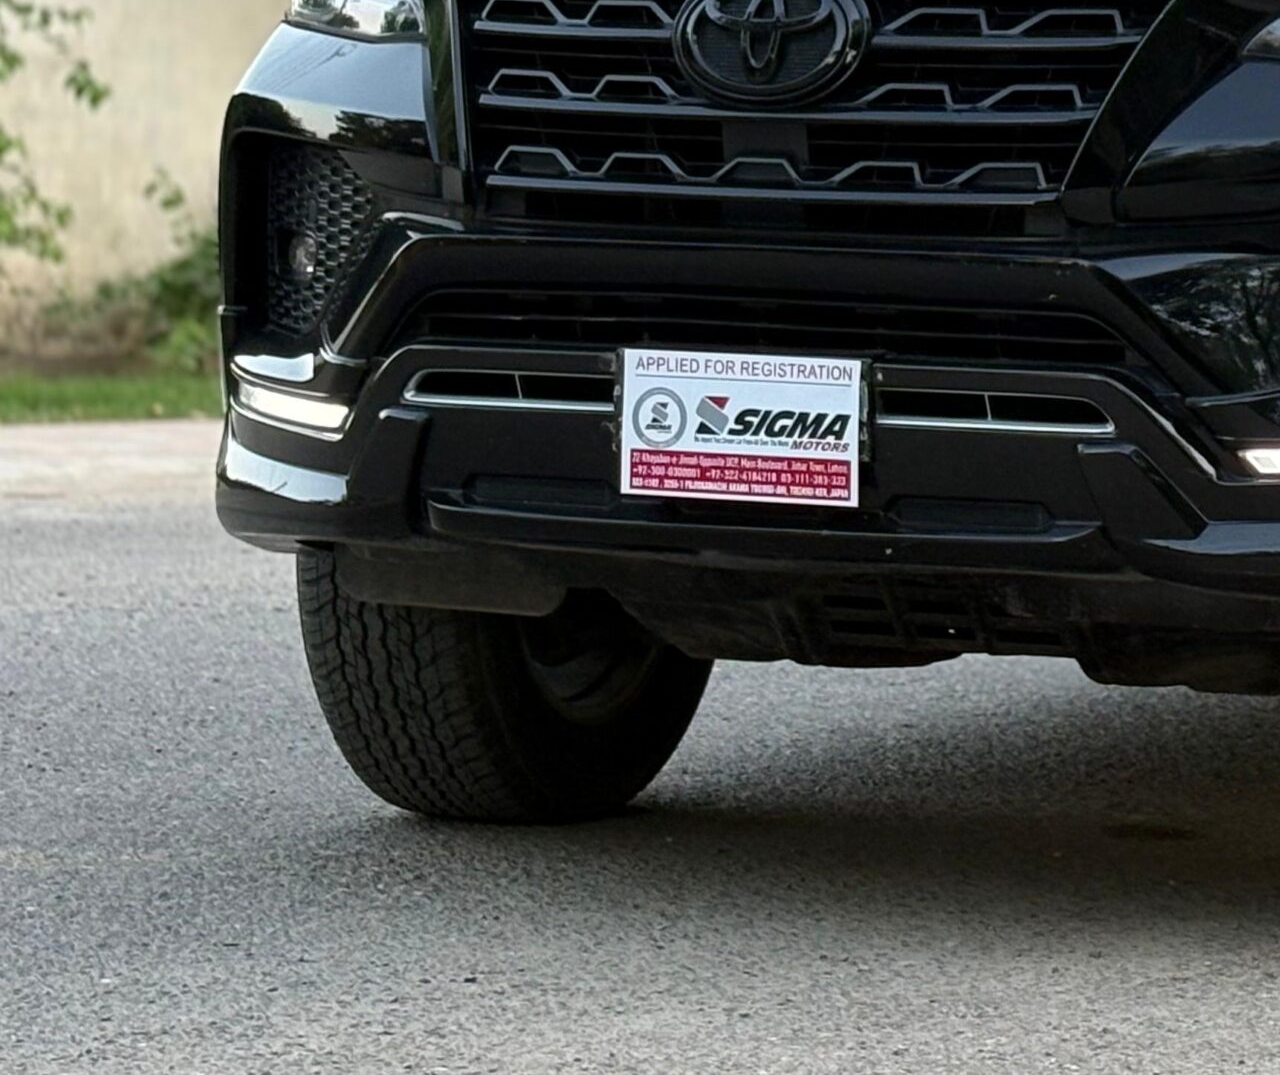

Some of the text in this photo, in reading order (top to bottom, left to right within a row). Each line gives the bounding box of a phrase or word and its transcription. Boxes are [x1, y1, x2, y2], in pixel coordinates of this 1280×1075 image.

[635, 355, 853, 382] APPLIED FOR REGISTRATION
[728, 408, 851, 440] SIGMA
[790, 439, 850, 453] MOTORS
